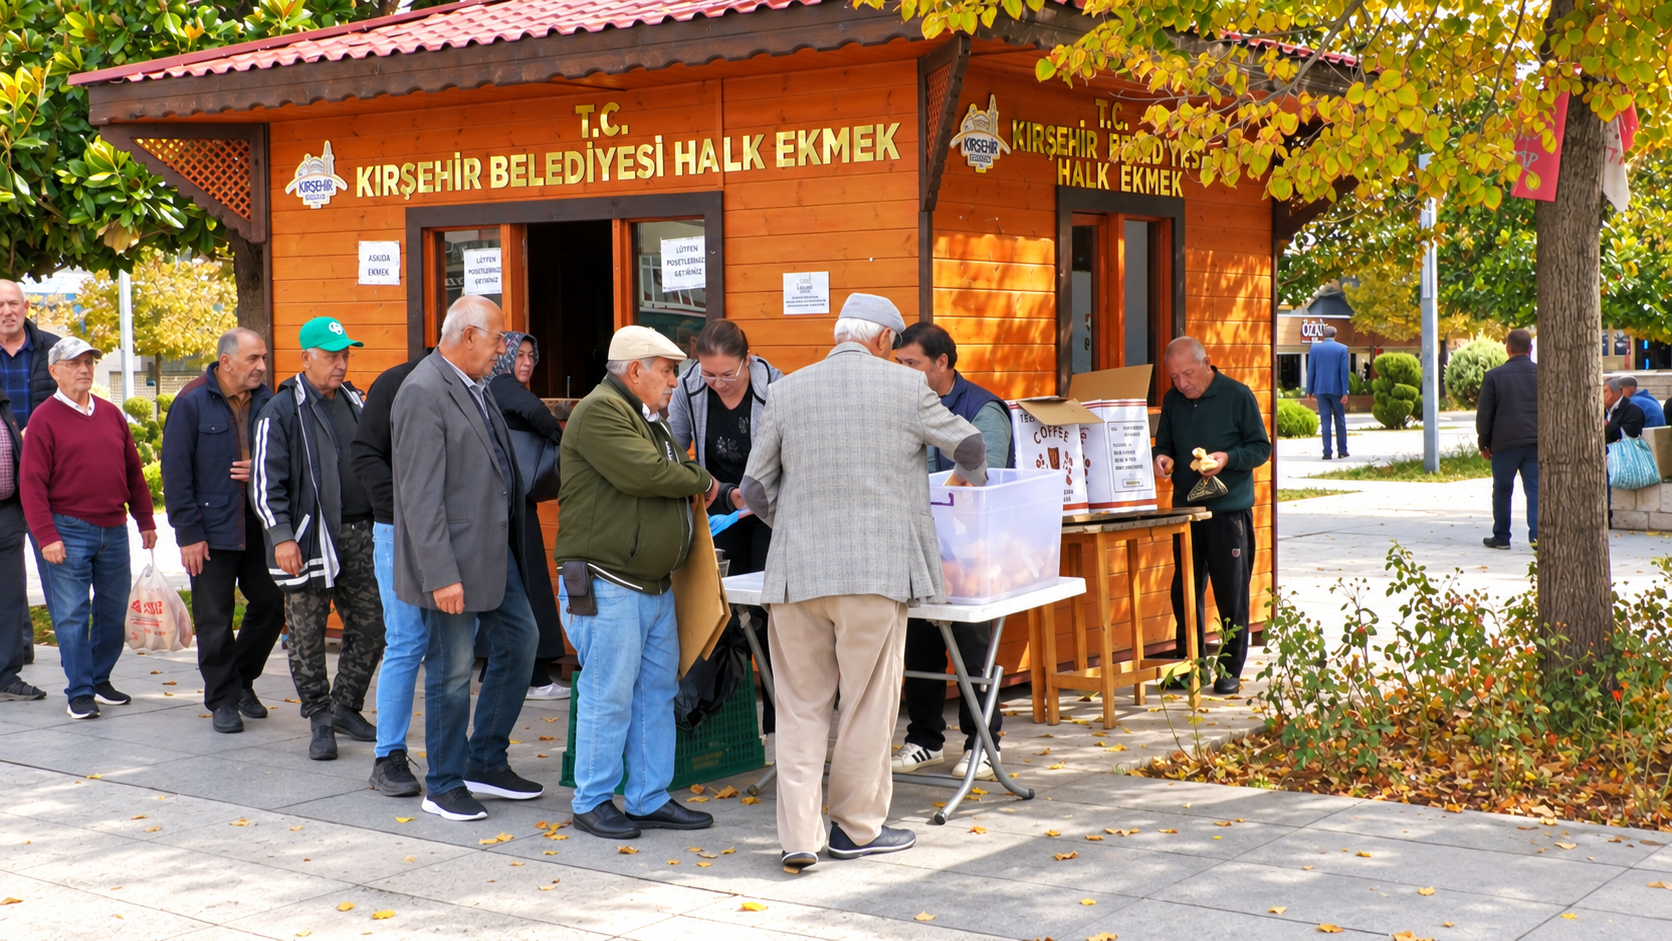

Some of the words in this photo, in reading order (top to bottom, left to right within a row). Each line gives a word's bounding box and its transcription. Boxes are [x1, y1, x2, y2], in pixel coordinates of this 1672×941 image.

[575, 102, 629, 138] T.C.
[1095, 98, 1129, 131] T.C.
[1012, 119, 1098, 161] KIRŞEHİR
[356, 152, 482, 200] KIRŞEHİR
[490, 135, 664, 189] BELEDİYESİ
[674, 134, 766, 176] HALK
[776, 122, 900, 168] EKMEK
[1058, 158, 1110, 189] HALK
[1121, 164, 1184, 197] EKMEK
[1033, 424, 1070, 445] COFFEE
